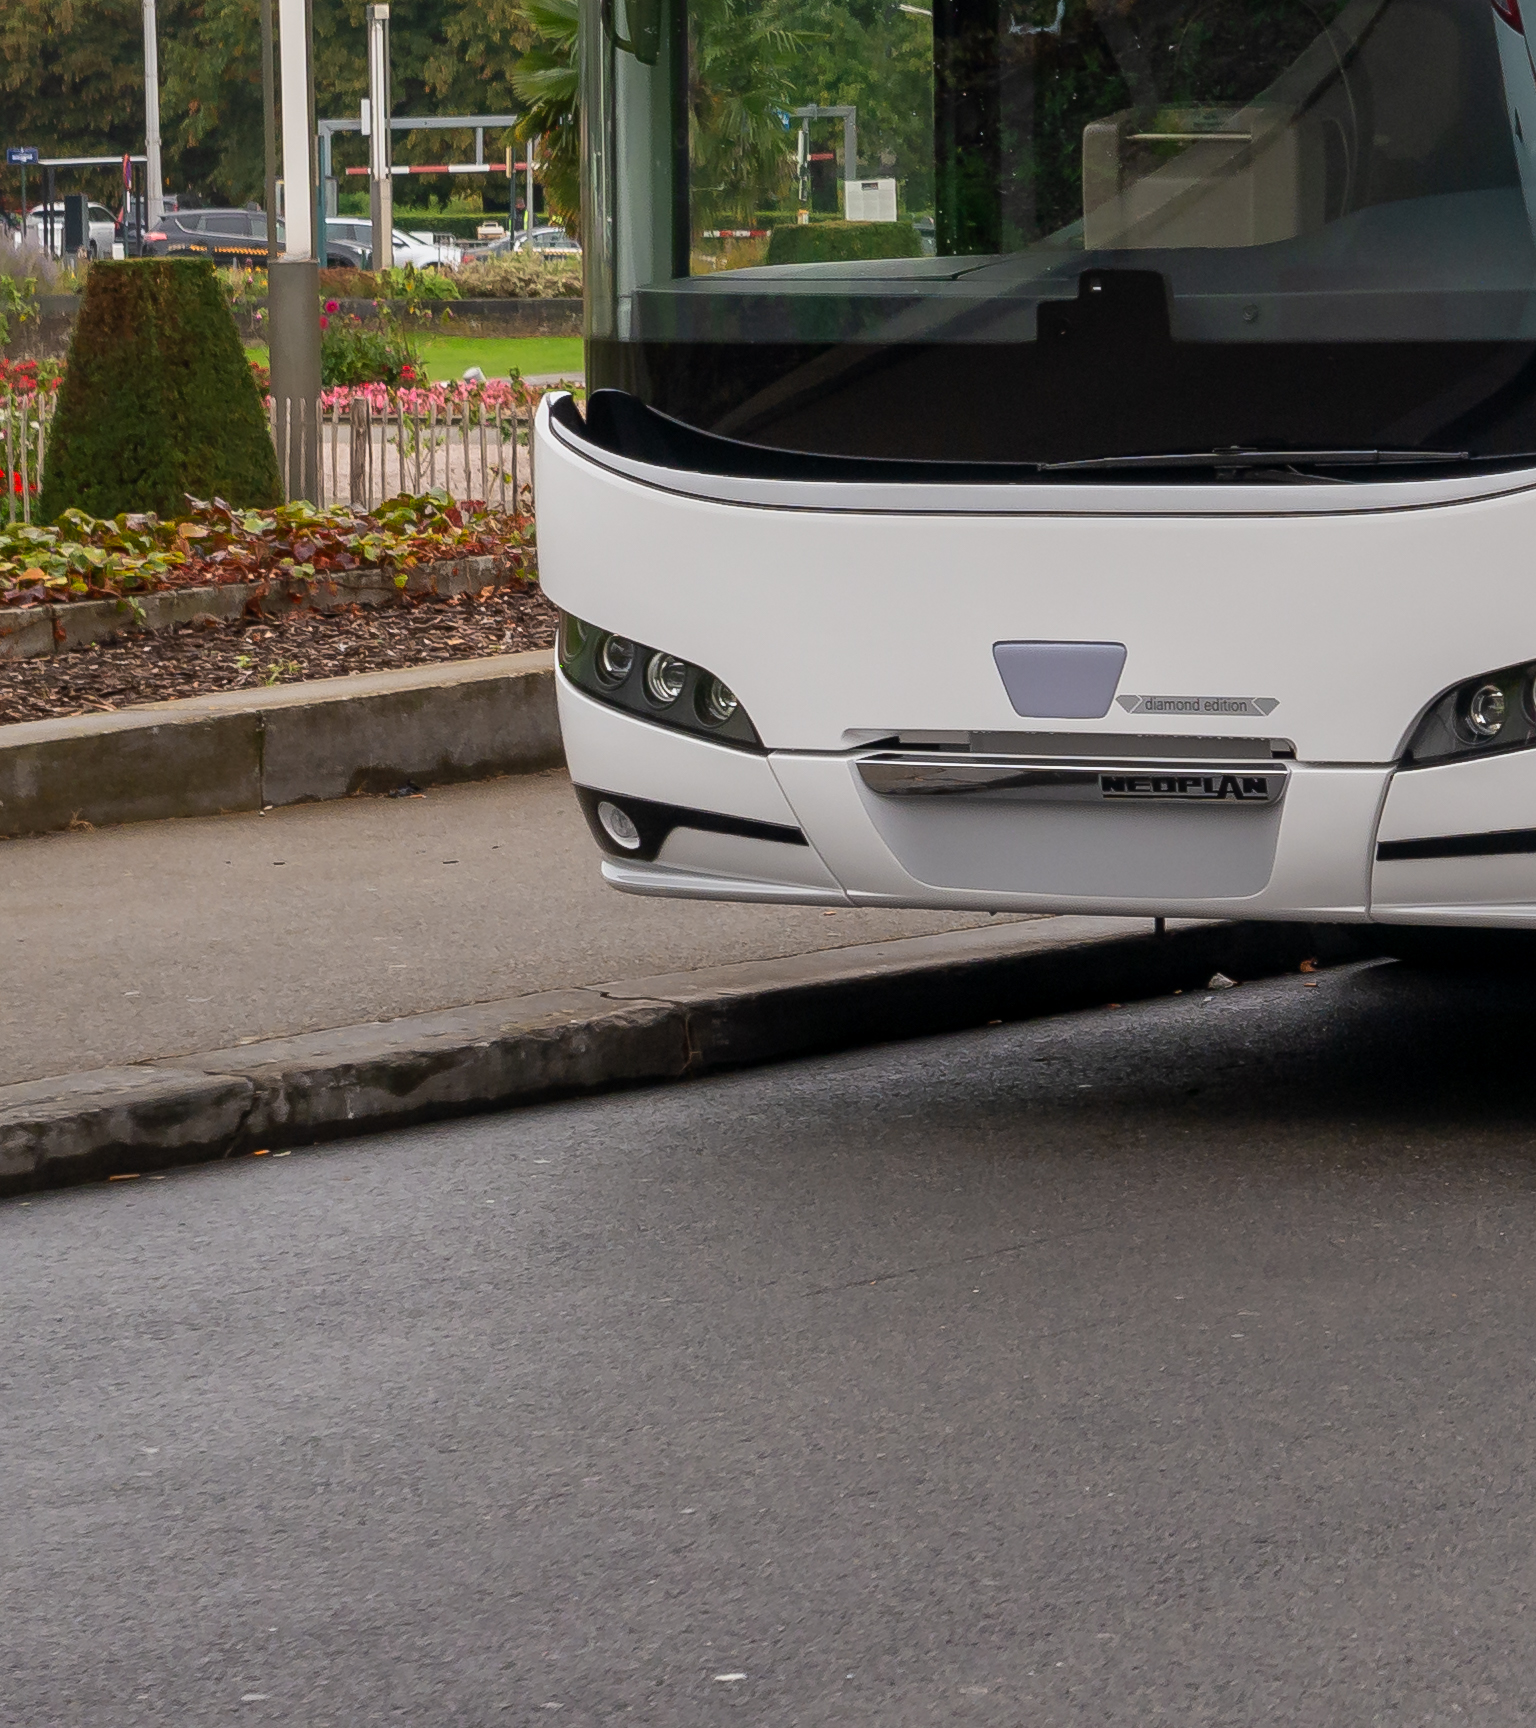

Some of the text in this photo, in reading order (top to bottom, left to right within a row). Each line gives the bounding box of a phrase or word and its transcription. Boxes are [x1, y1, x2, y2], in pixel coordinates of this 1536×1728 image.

[1144, 697, 1248, 713] diamond edition
[1100, 774, 1269, 801] NEOPLAN
